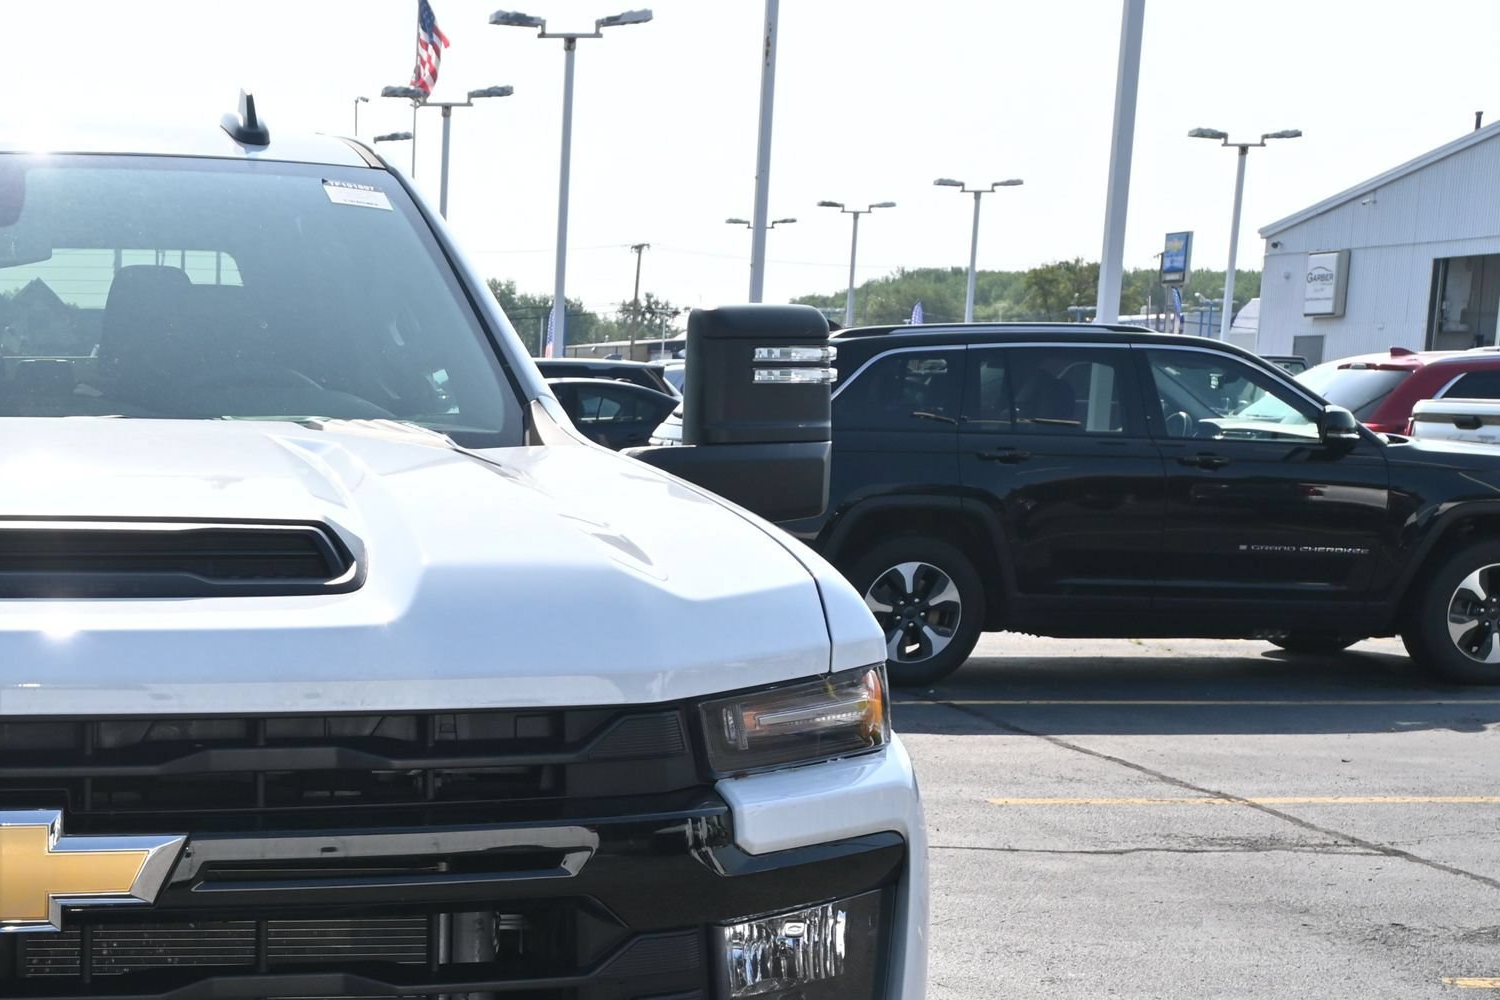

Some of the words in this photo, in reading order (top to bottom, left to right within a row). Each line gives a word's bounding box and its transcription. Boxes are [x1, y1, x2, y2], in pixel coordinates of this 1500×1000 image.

[1306, 272, 1334, 283] GARBER
[1251, 544, 1296, 552] GRAND
[1299, 546, 1370, 554] CHEROKEE
